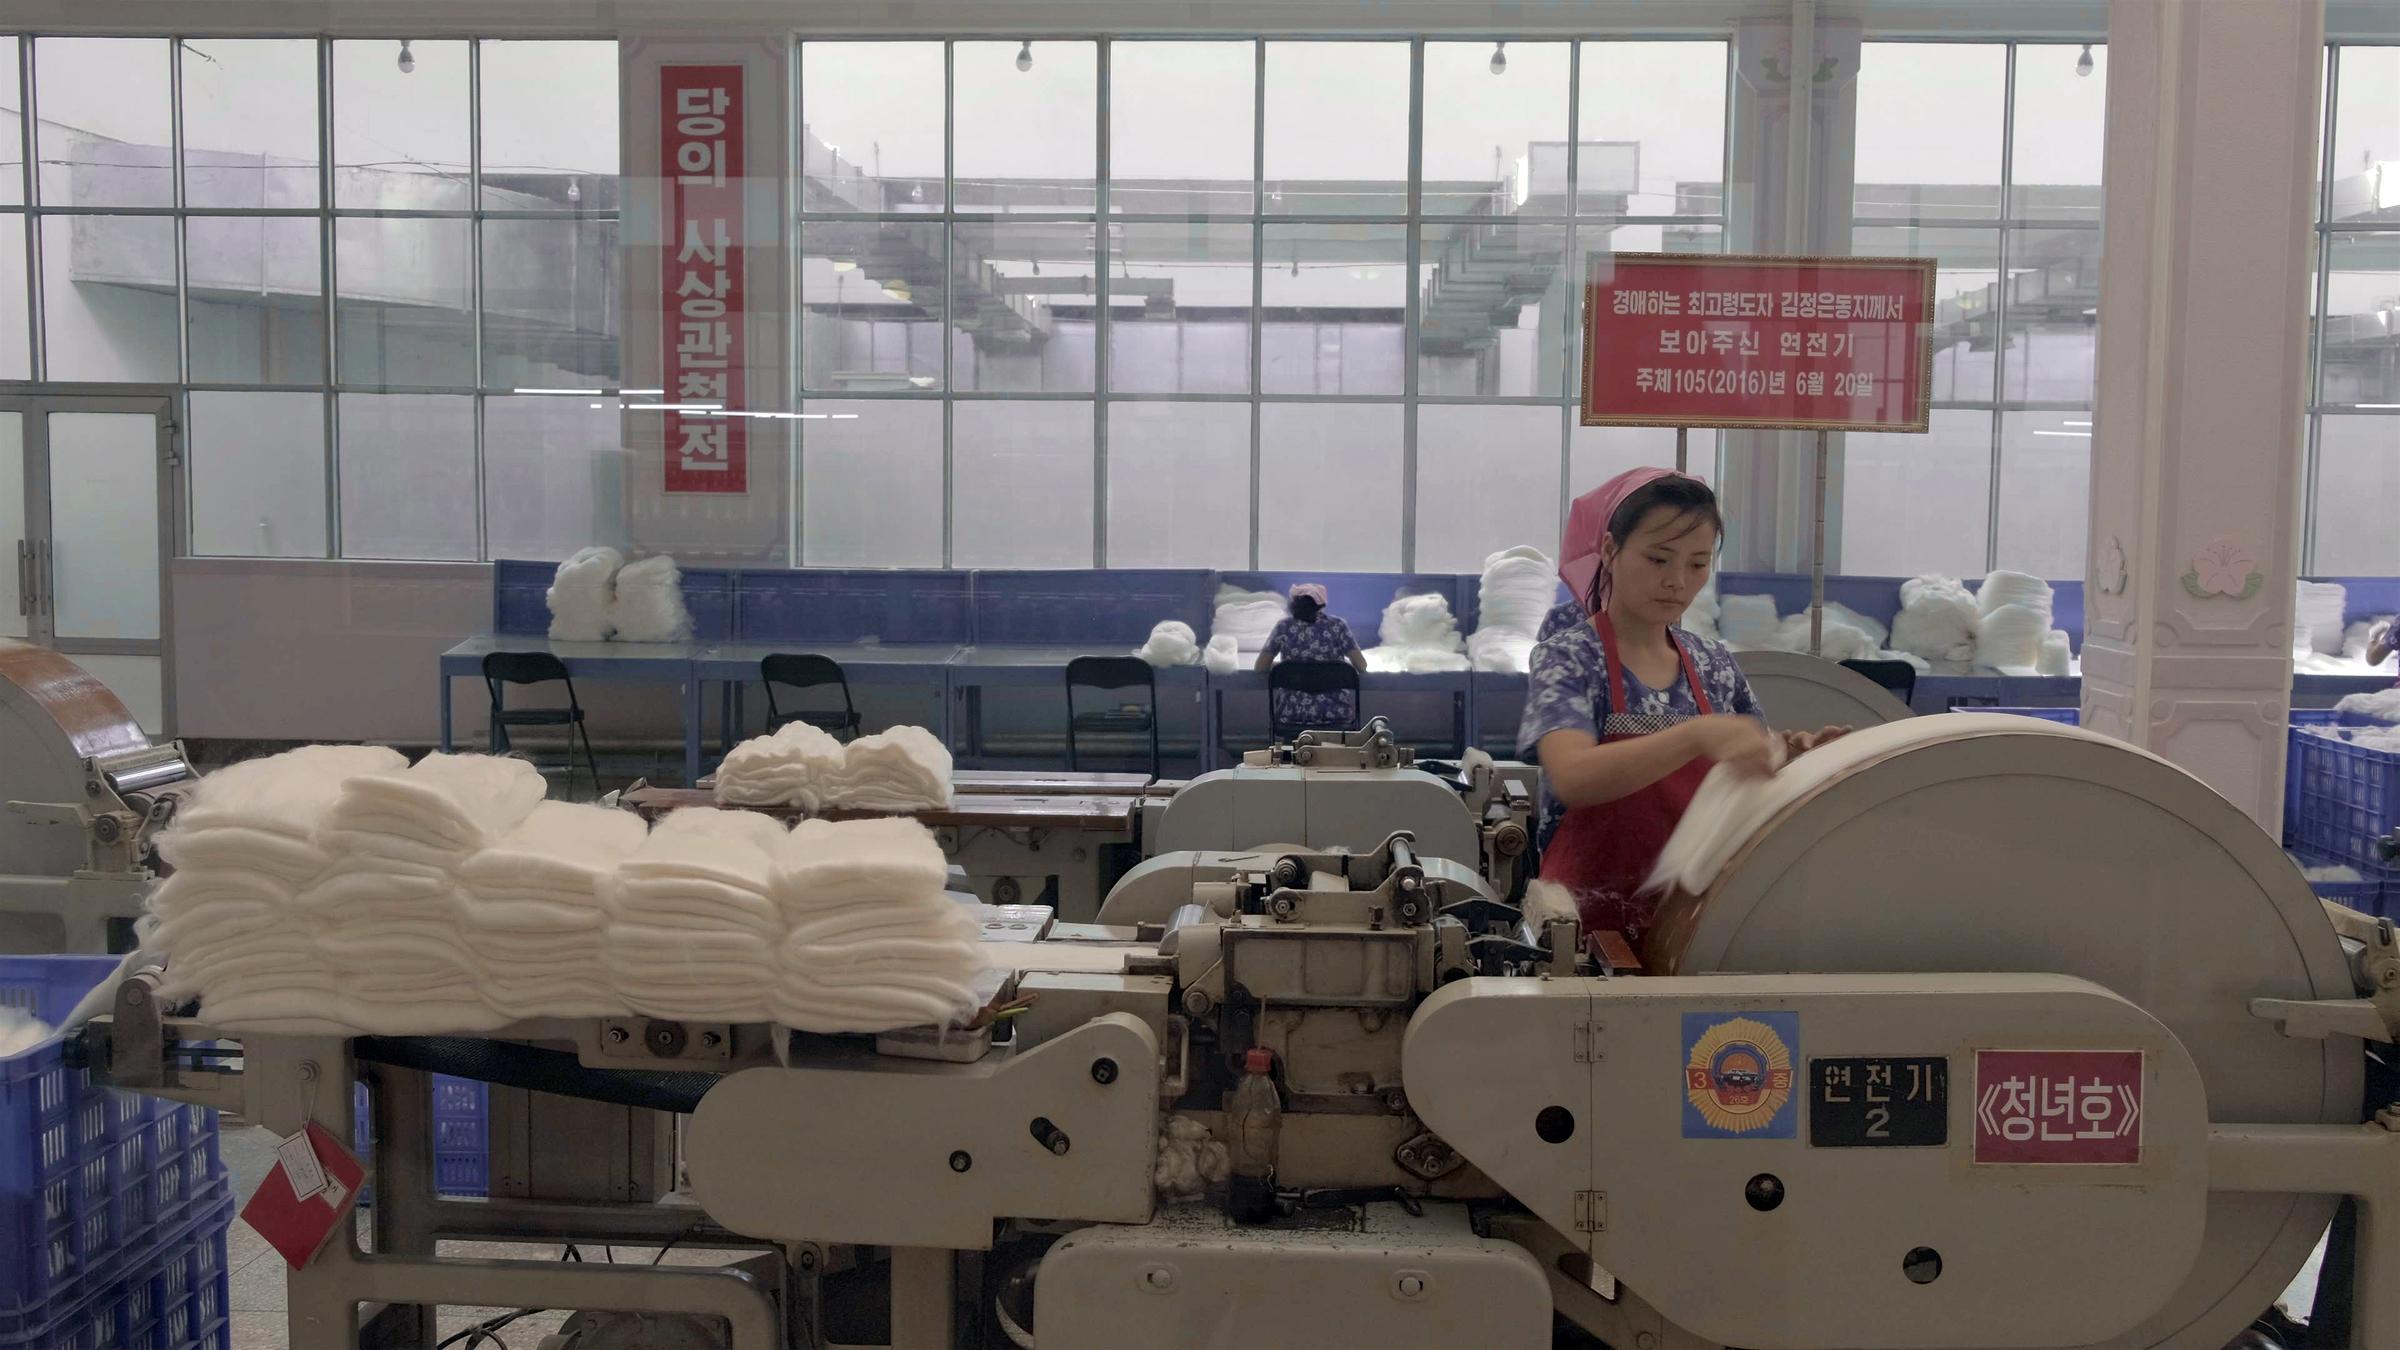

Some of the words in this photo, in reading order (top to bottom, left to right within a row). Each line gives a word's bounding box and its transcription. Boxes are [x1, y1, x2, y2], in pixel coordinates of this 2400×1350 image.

[677, 88, 730, 188] 당의
[1613, 290, 1680, 316] 경애하는
[1687, 291, 1774, 317] 최고령도자
[1781, 292, 1904, 320] 김정은동지께서
[677, 218, 732, 471] 사상관철전
[1659, 330, 1760, 356] 보아주신
[1780, 332, 1854, 358] 연전기
[1636, 367, 1785, 396] 주체105(2016)년
[1796, 371, 1825, 396] 6월
[1834, 372, 1873, 397] 20일
[1694, 1071, 1708, 1089] 3
[1865, 1108, 1890, 1138] 2
